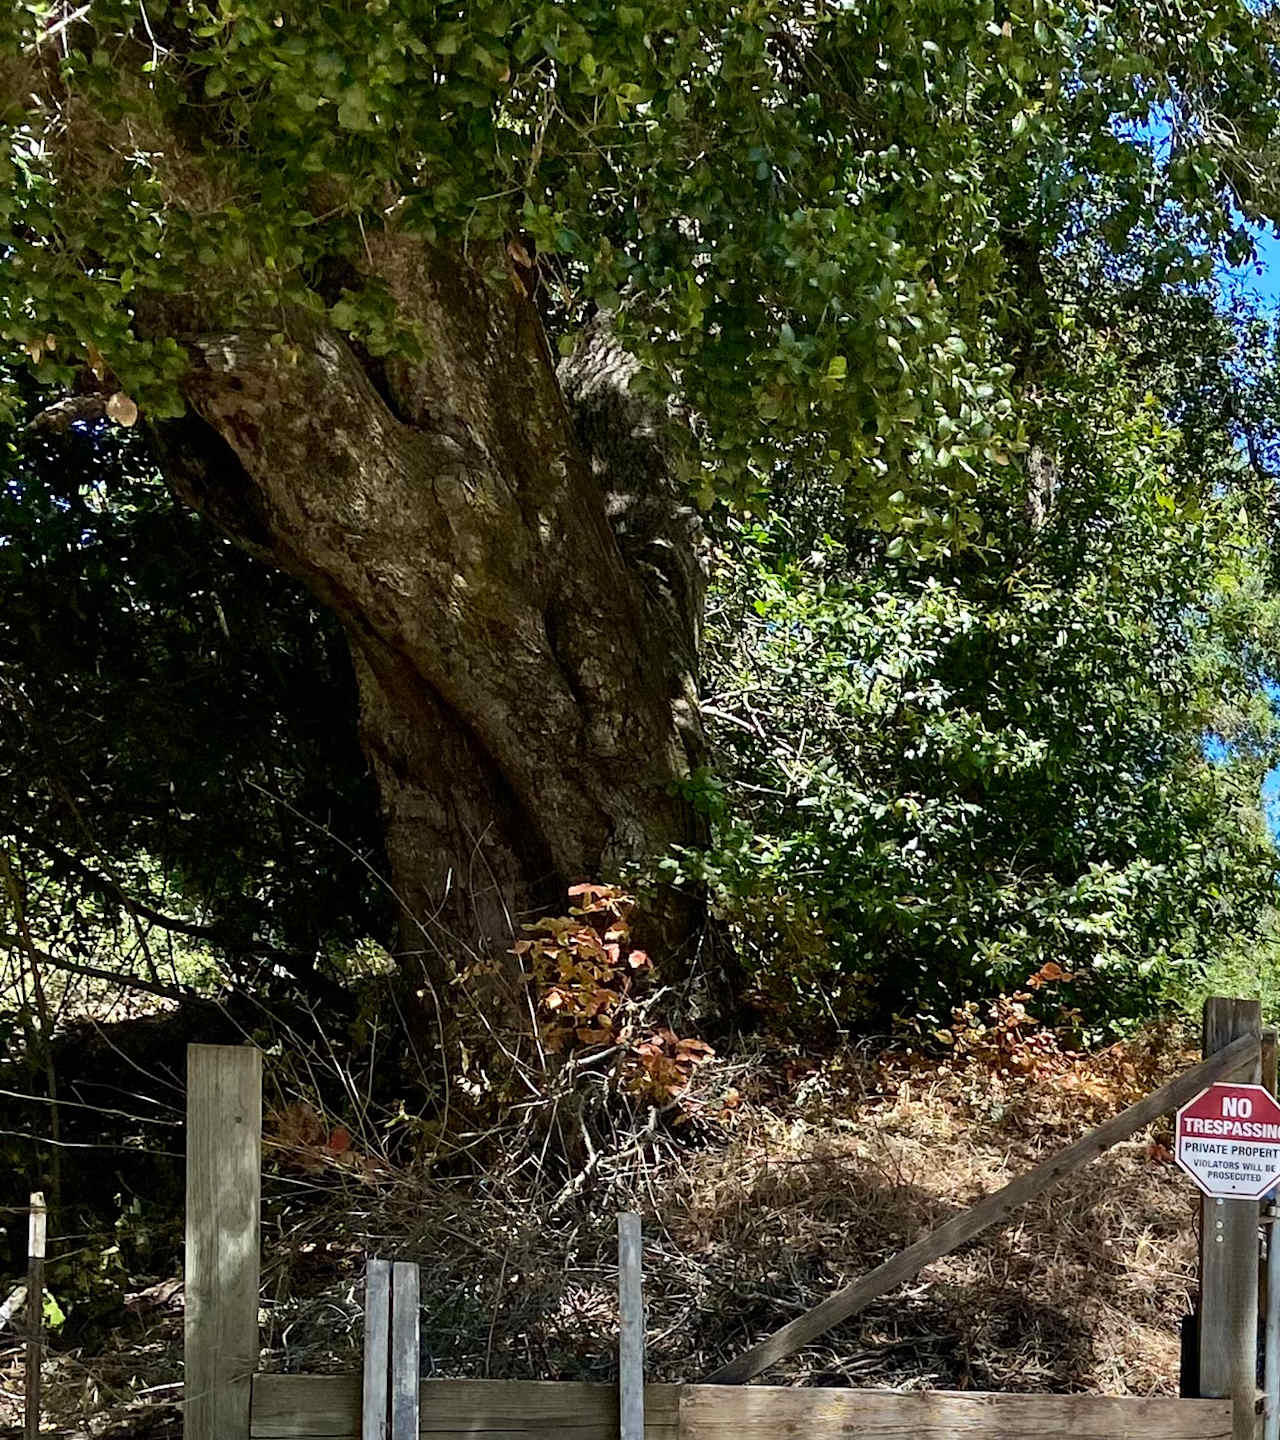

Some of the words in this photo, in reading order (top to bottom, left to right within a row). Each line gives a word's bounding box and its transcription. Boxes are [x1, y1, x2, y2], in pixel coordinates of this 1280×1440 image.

[1222, 1097, 1252, 1118] NO
[1185, 1142, 1228, 1155] PRIVATE
[1193, 1159, 1240, 1170] VIOLATORS
[1242, 1162, 1263, 1172] WILL
[1265, 1164, 1276, 1172] BE
[1207, 1171, 1261, 1182] PROSECUTED
